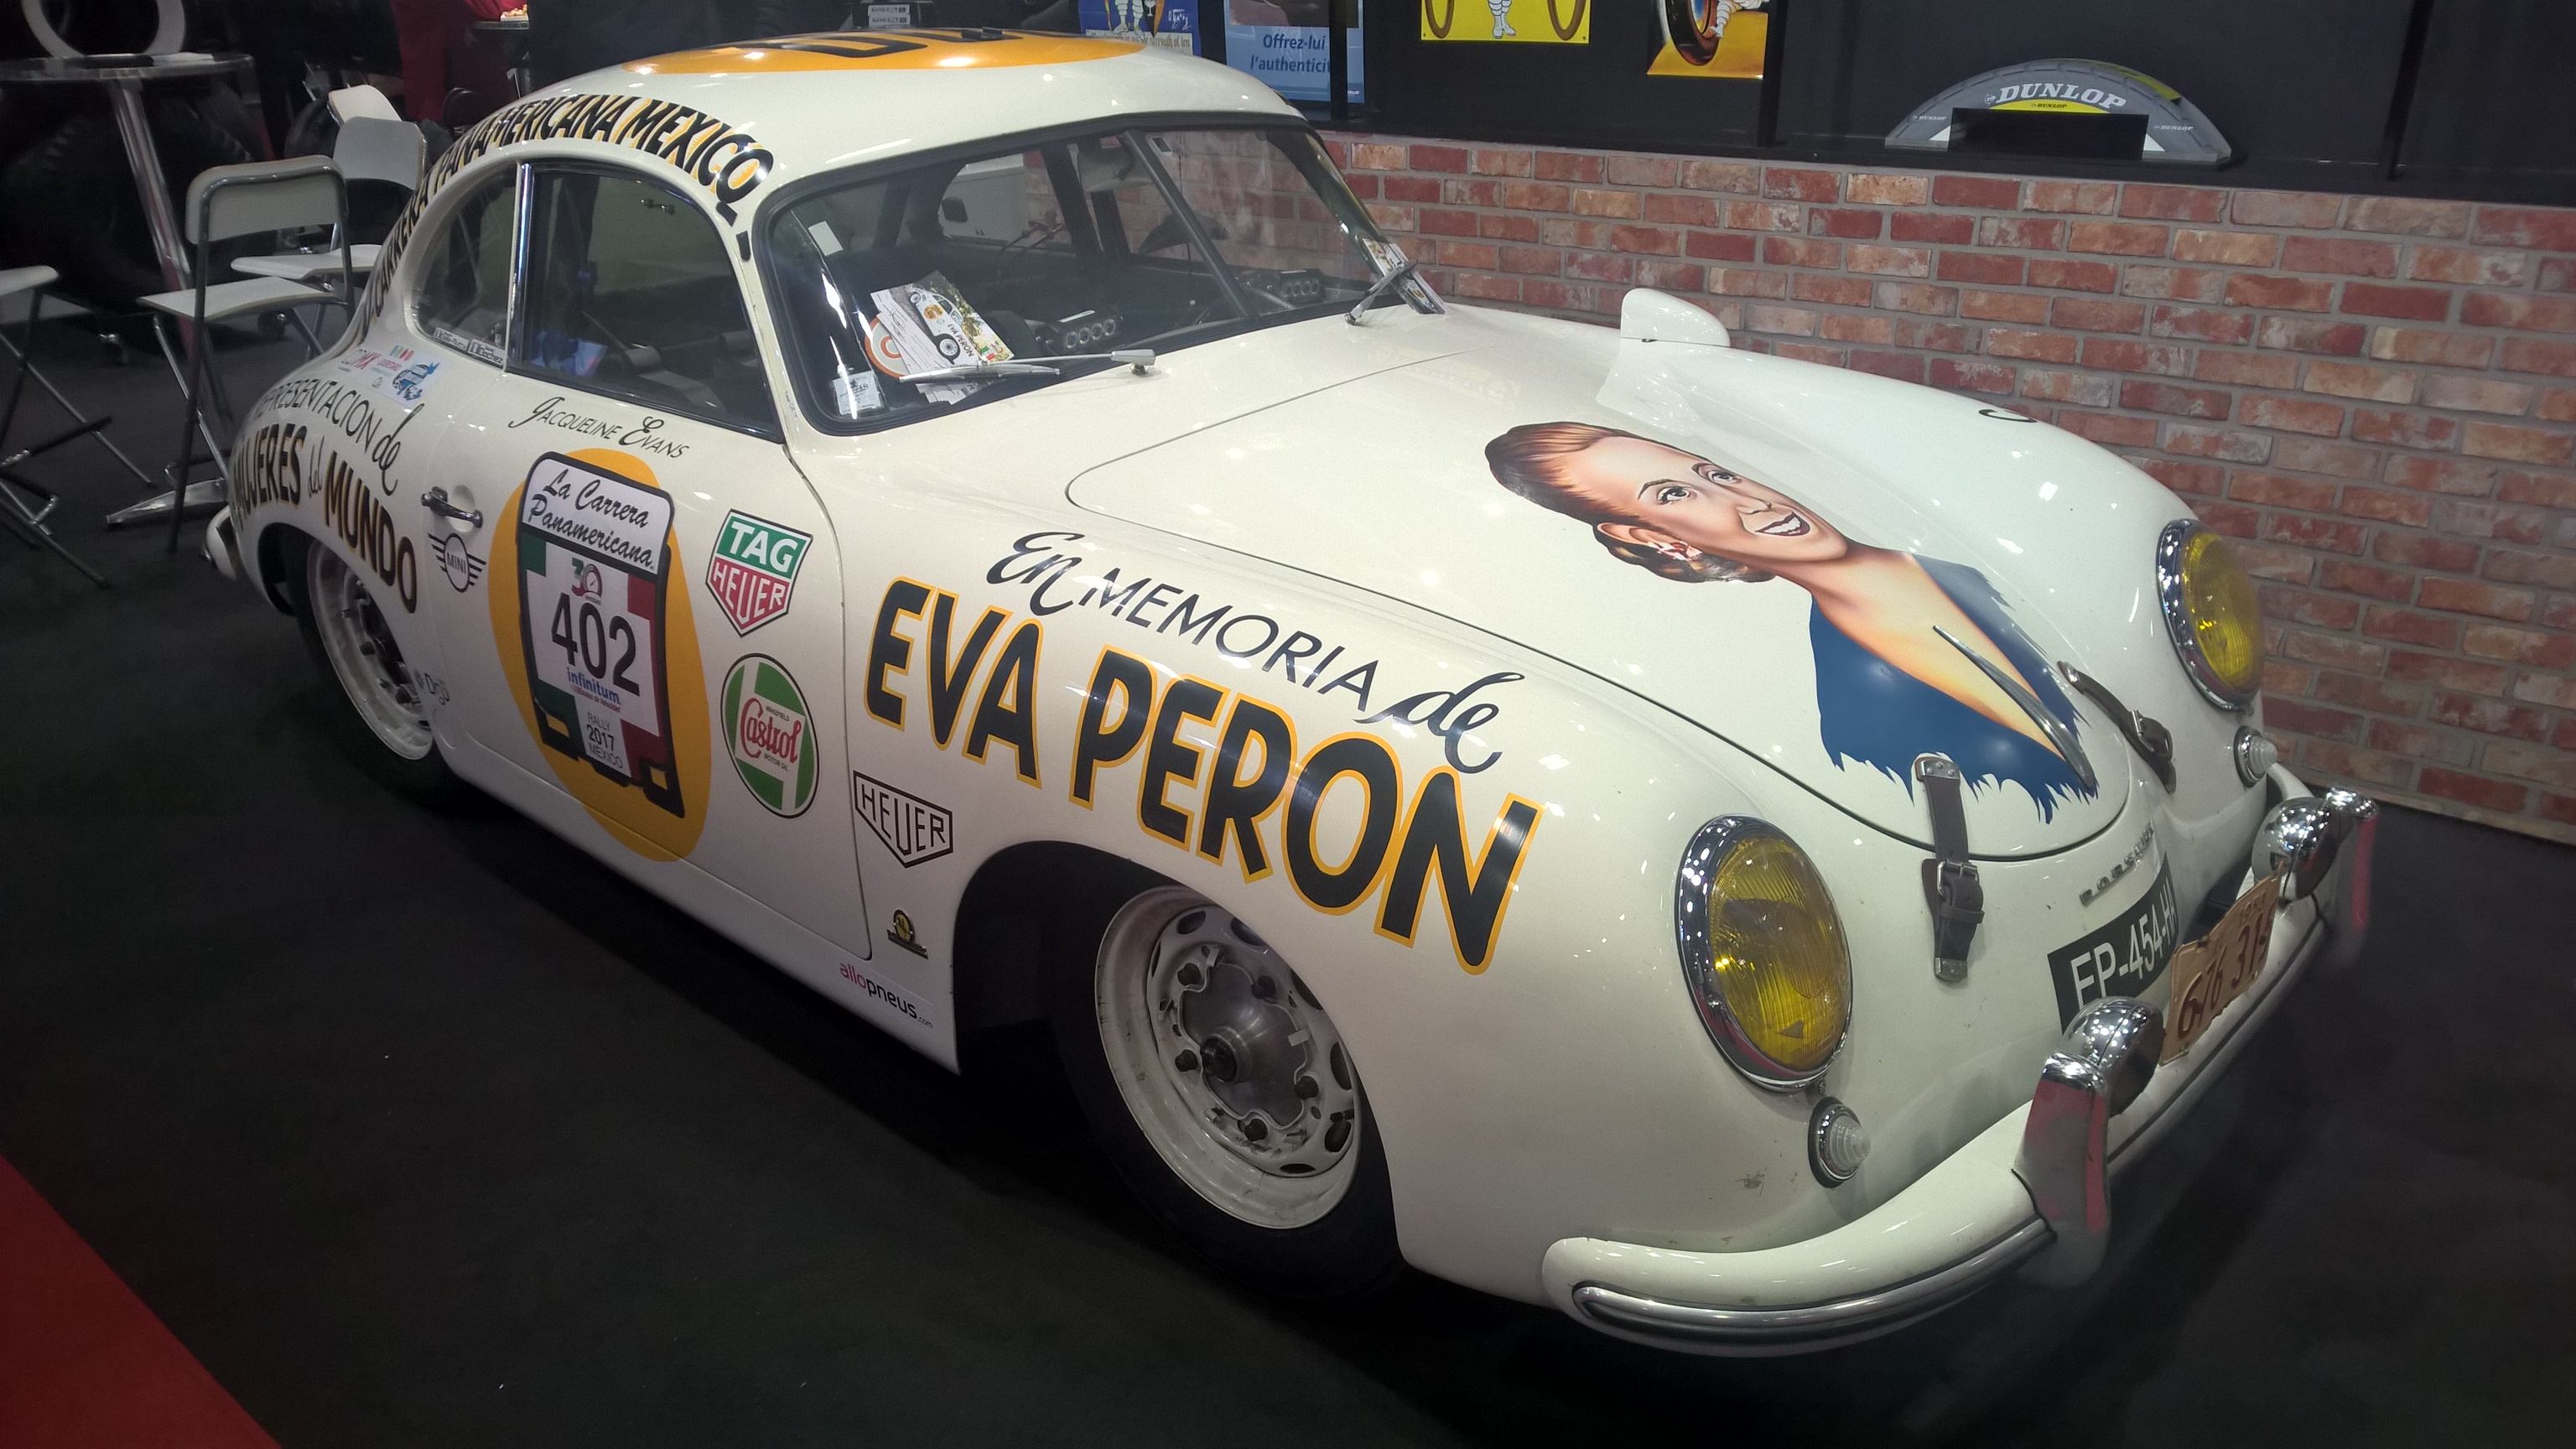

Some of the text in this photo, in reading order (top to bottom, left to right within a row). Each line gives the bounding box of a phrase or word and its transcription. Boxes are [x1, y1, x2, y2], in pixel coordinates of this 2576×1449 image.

[1263, 34, 1326, 50] Offrez-lui
[1996, 82, 2127, 110] DUNLOP
[2037, 101, 2067, 110] DUNLOP
[618, 96, 775, 204] MEXICO
[956, 333, 974, 357] PERON
[371, 402, 425, 496] de
[543, 468, 649, 528] La Carrera
[323, 449, 418, 614] MUNDO
[528, 493, 653, 569] Panamericana
[729, 521, 798, 574] TAG
[445, 552, 467, 574] MINI
[713, 561, 787, 626] HEUER
[551, 591, 641, 698] 402
[985, 531, 1526, 774] En MEMORIA de
[567, 667, 621, 704] infinitum
[765, 704, 790, 722] WAKEFIELD
[587, 712, 610, 732] RALLY
[587, 724, 614, 751] 2017
[740, 697, 802, 765] Castrol
[589, 741, 623, 769] MEXICO
[764, 751, 789, 772] MOTOR OIL
[862, 575, 1547, 975] EVA PERON
[861, 782, 947, 857] HEUER
[839, 962, 933, 1030] allopneus.com
